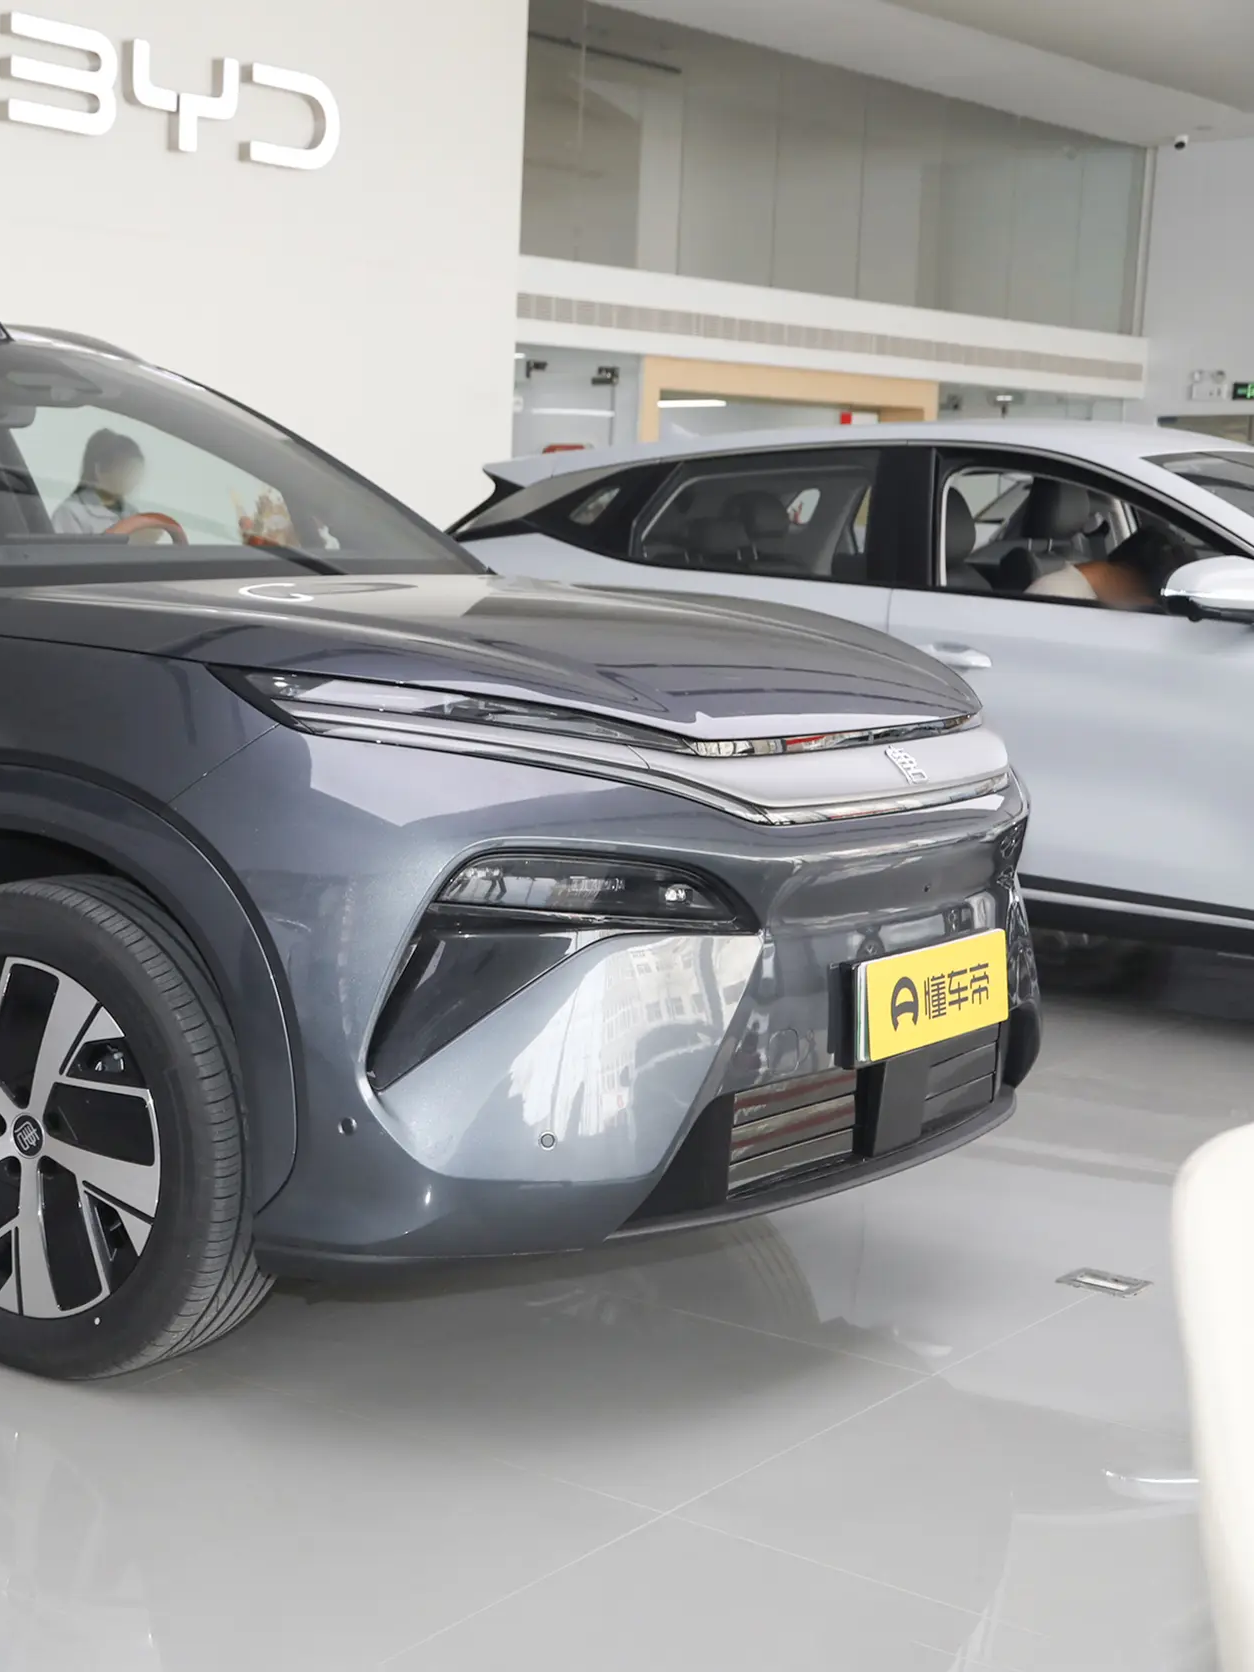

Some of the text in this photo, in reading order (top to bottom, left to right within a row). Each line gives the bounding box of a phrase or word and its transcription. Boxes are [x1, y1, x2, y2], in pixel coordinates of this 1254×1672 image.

[0, 11, 340, 170] BYD
[924, 963, 990, 1020] 懂车帝
